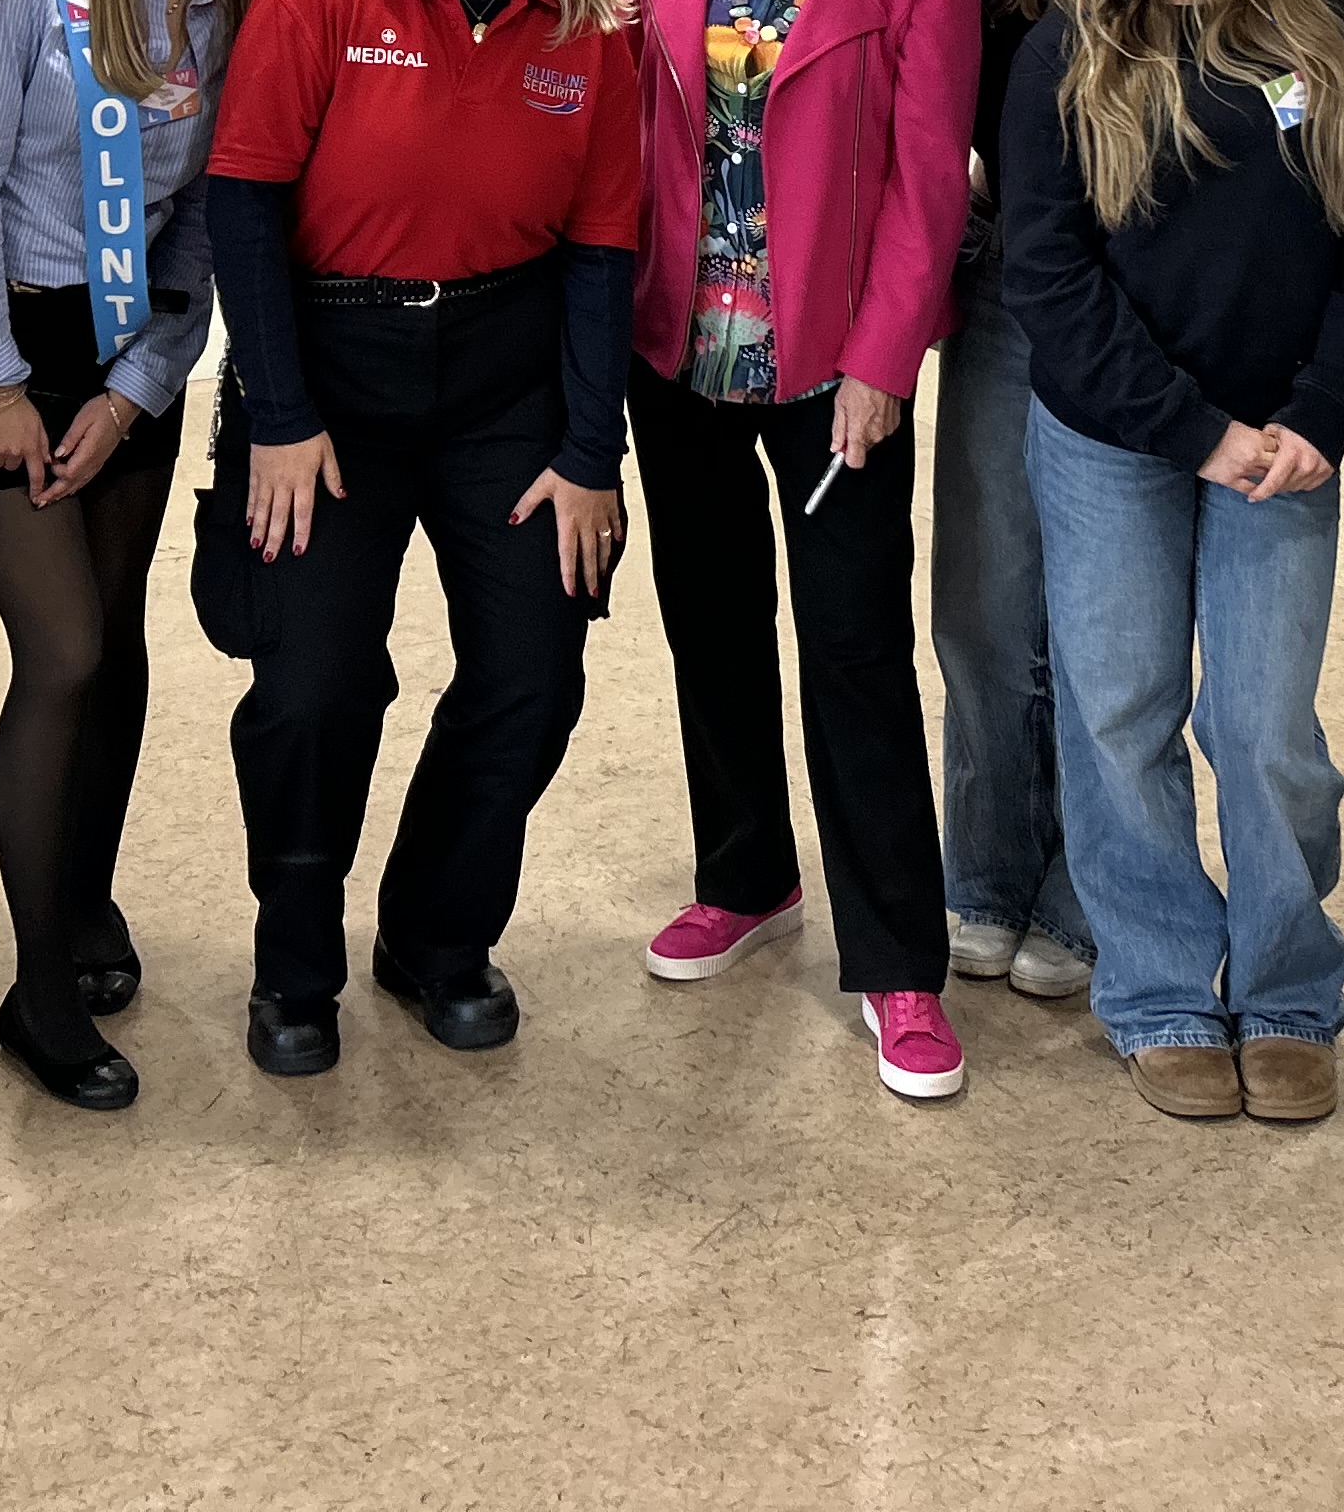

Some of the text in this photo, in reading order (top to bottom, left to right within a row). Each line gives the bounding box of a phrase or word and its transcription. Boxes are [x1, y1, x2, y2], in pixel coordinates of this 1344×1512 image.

[346, 45, 429, 68] MEDICAL
[522, 75, 586, 103] SECURITY
[524, 62, 590, 90] BLUELINE
[82, 47, 137, 351] OLUNT
